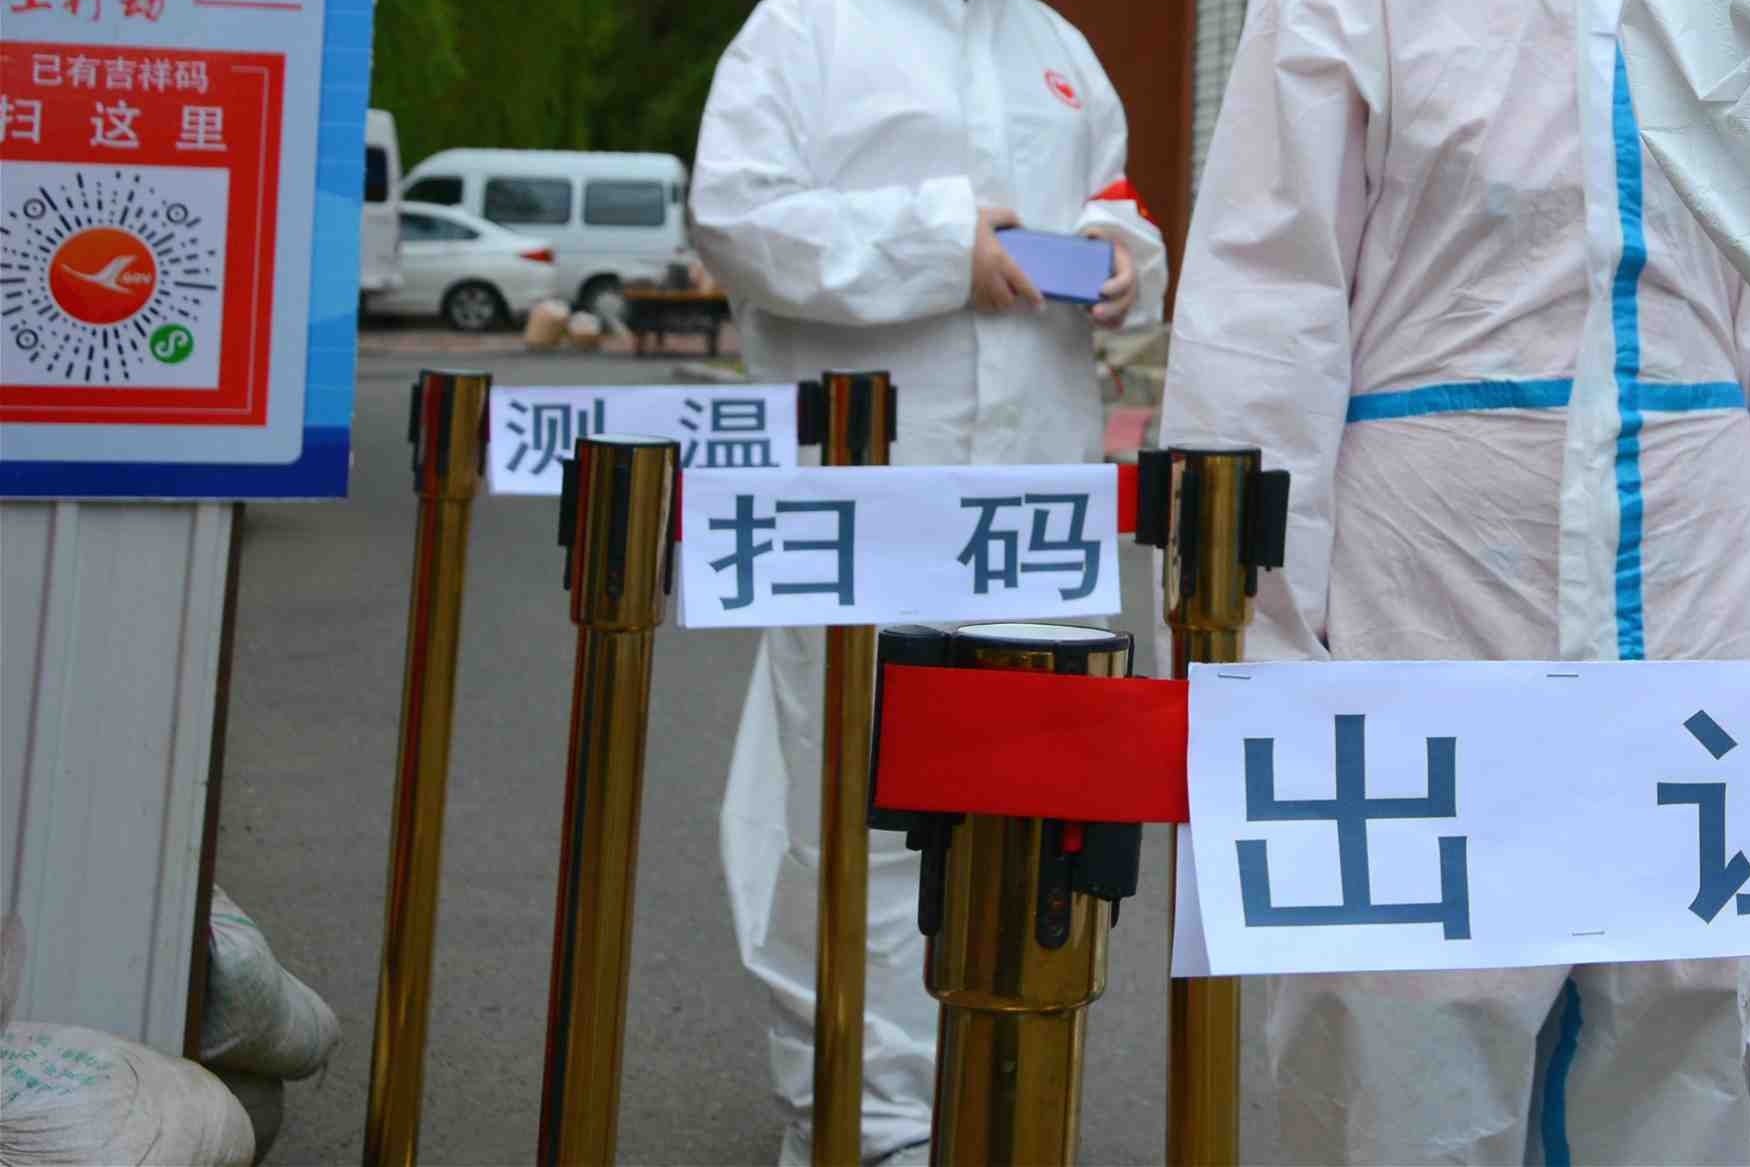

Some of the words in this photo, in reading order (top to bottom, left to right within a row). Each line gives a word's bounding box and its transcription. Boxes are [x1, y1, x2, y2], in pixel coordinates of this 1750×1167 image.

[32, 53, 209, 94] 已有吉祥码
